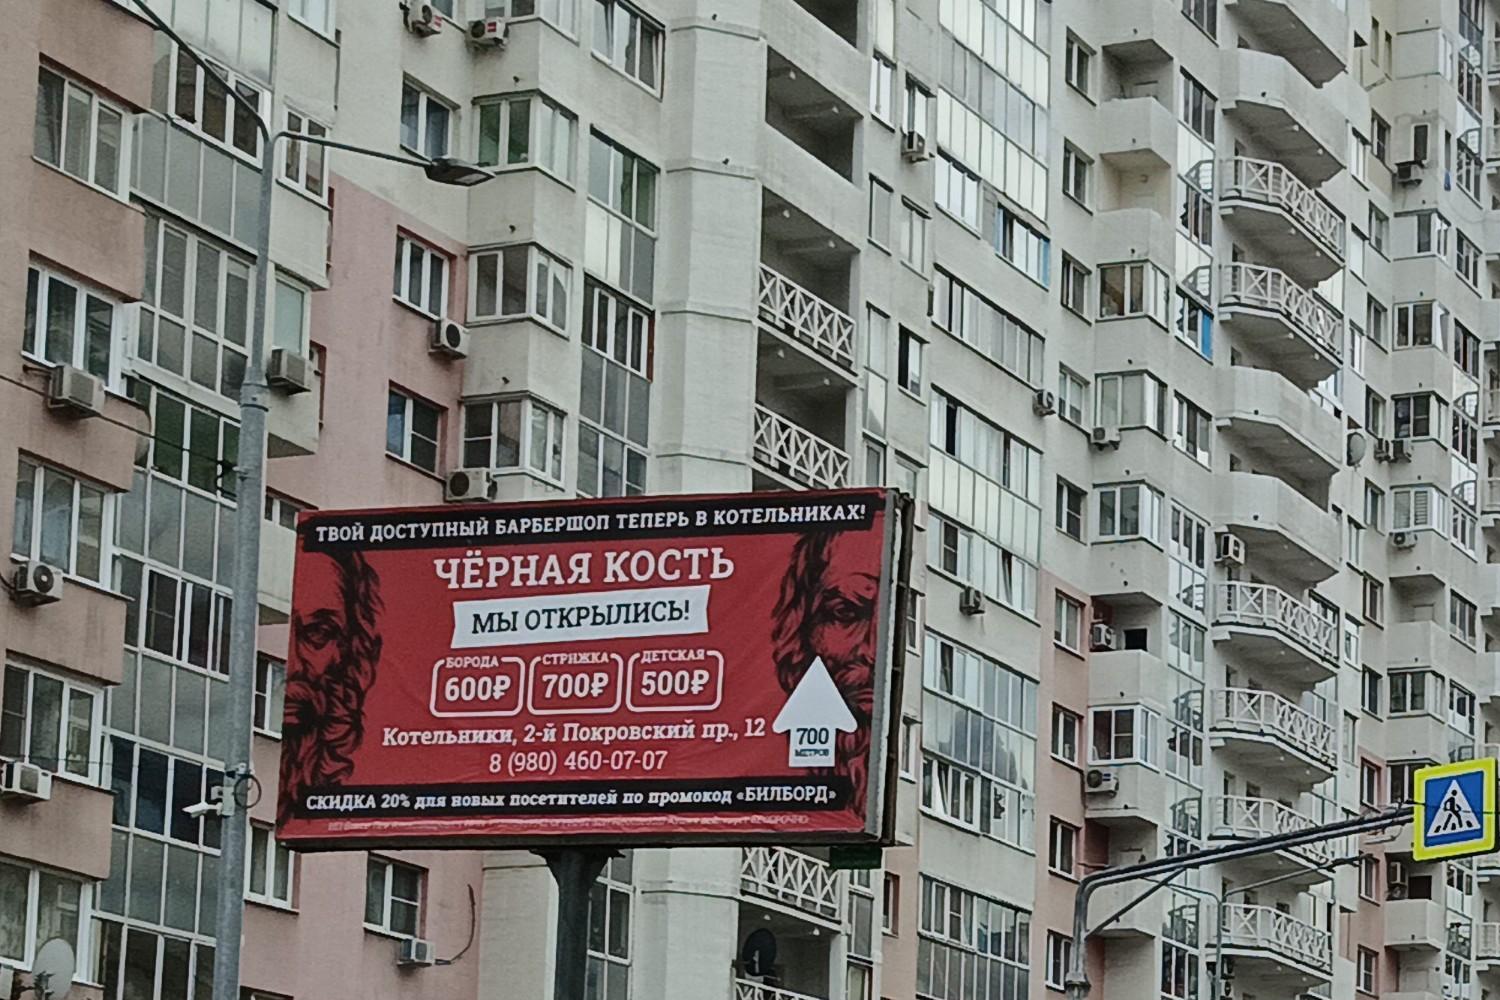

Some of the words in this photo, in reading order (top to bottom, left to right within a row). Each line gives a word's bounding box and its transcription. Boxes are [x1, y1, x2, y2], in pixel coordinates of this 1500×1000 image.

[316, 522, 365, 542] ТВОЙ
[369, 517, 490, 543] ДОСТУПНЫЙ
[495, 515, 610, 534] БАРБЕРШОП
[617, 510, 690, 529] ТЕПЕРЬ
[695, 510, 708, 526] В
[713, 504, 867, 525] КОТЕЛЬНИКАХ!
[433, 549, 592, 590] ЧЁРНАЯ
[603, 547, 735, 583] КОСТЬ
[471, 611, 518, 635] МЫ
[525, 599, 690, 632] ОТКРЫЛИСЬ!
[445, 656, 499, 669] БОРОДА
[542, 651, 609, 667] СТРИЖКА
[641, 648, 705, 664] ДЕТСКАЯ
[444, 675, 511, 702] 600₽
[541, 672, 609, 698] 700₽
[641, 669, 710, 696] 500₽
[382, 727, 518, 746] Котельники,
[523, 722, 556, 742] 2-й
[562, 719, 696, 745] Покровский
[701, 725, 739, 744] пр.,
[744, 718, 766, 738] 12
[796, 727, 829, 745] 700
[489, 754, 502, 773] 8
[507, 751, 558, 777] (980)
[564, 749, 669, 771] 460-07-07
[306, 794, 376, 812] СКИДКА
[381, 793, 411, 809] 20%
[414, 795, 447, 810] для
[451, 795, 505, 808] новых
[509, 789, 618, 807] посетителей
[622, 794, 644, 806] по
[648, 790, 733, 807] промокод
[736, 786, 838, 803] «БИЛБОРД»
